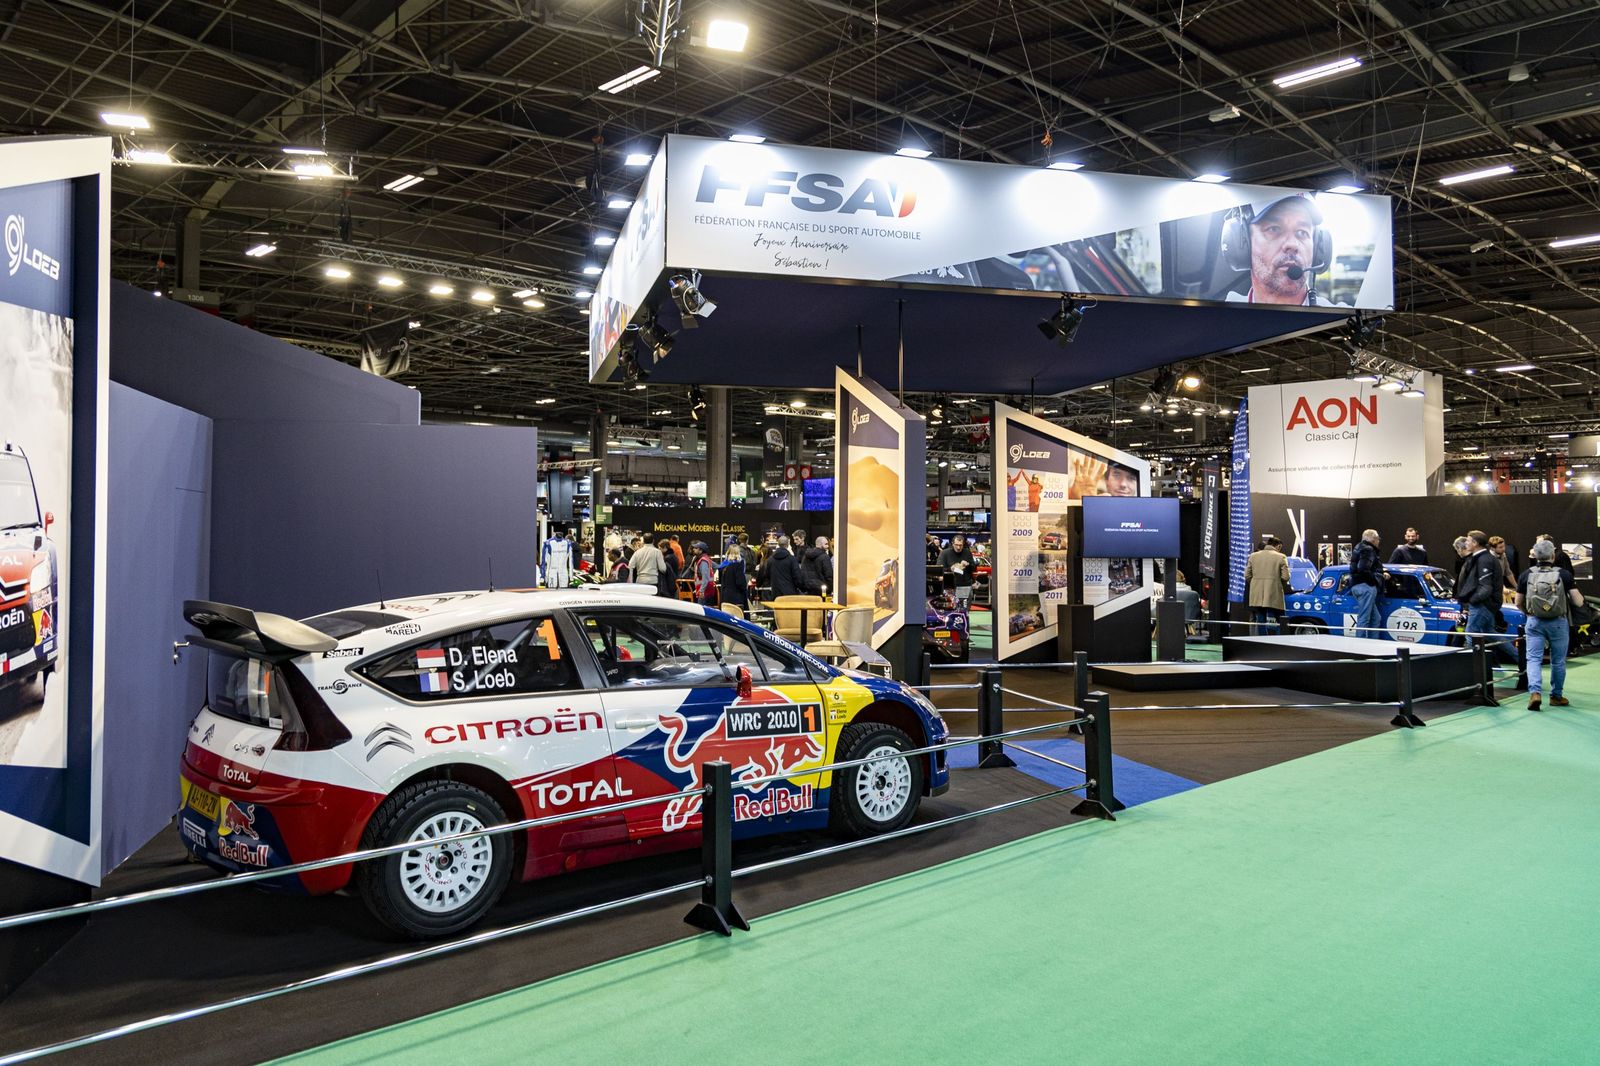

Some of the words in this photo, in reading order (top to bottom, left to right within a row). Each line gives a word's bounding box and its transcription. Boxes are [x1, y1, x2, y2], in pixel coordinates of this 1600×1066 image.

[695, 165, 895, 217] FFSA
[694, 215, 755, 229] FÉDÉRATION
[757, 218, 810, 233] FRANÇAISE
[813, 222, 827, 233] DU
[829, 224, 859, 236] SPORT
[861, 226, 921, 240] AUTOMOBILE
[753, 233, 786, 250] Joyeux
[790, 236, 849, 252] Anniversaire
[23, 243, 60, 280] LOEB
[774, 251, 822, 268] Sébastien
[1286, 395, 1377, 430] AON
[1305, 431, 1340, 442] Classic
[1342, 430, 1359, 440] Car
[1022, 451, 1051, 459] LOEB
[1043, 491, 1064, 499] 2008
[1013, 569, 1033, 577] 2010
[1084, 574, 1102, 582] 2012
[1396, 621, 1418, 631] 198
[536, 619, 561, 660] 1
[326, 648, 360, 658] Sabelt
[449, 647, 468, 666] D.
[472, 645, 518, 666] Elena
[453, 670, 470, 691] S.
[475, 668, 516, 689] Loeb
[730, 712, 762, 732] WRC
[767, 710, 797, 729] 2010
[804, 705, 816, 732] 1
[223, 764, 252, 783] TOTAL
[531, 777, 632, 809] TOTAL
[734, 789, 775, 822] Red
[775, 783, 812, 814] Bull
[218, 837, 241, 861] Red
[239, 840, 269, 866] Bull
